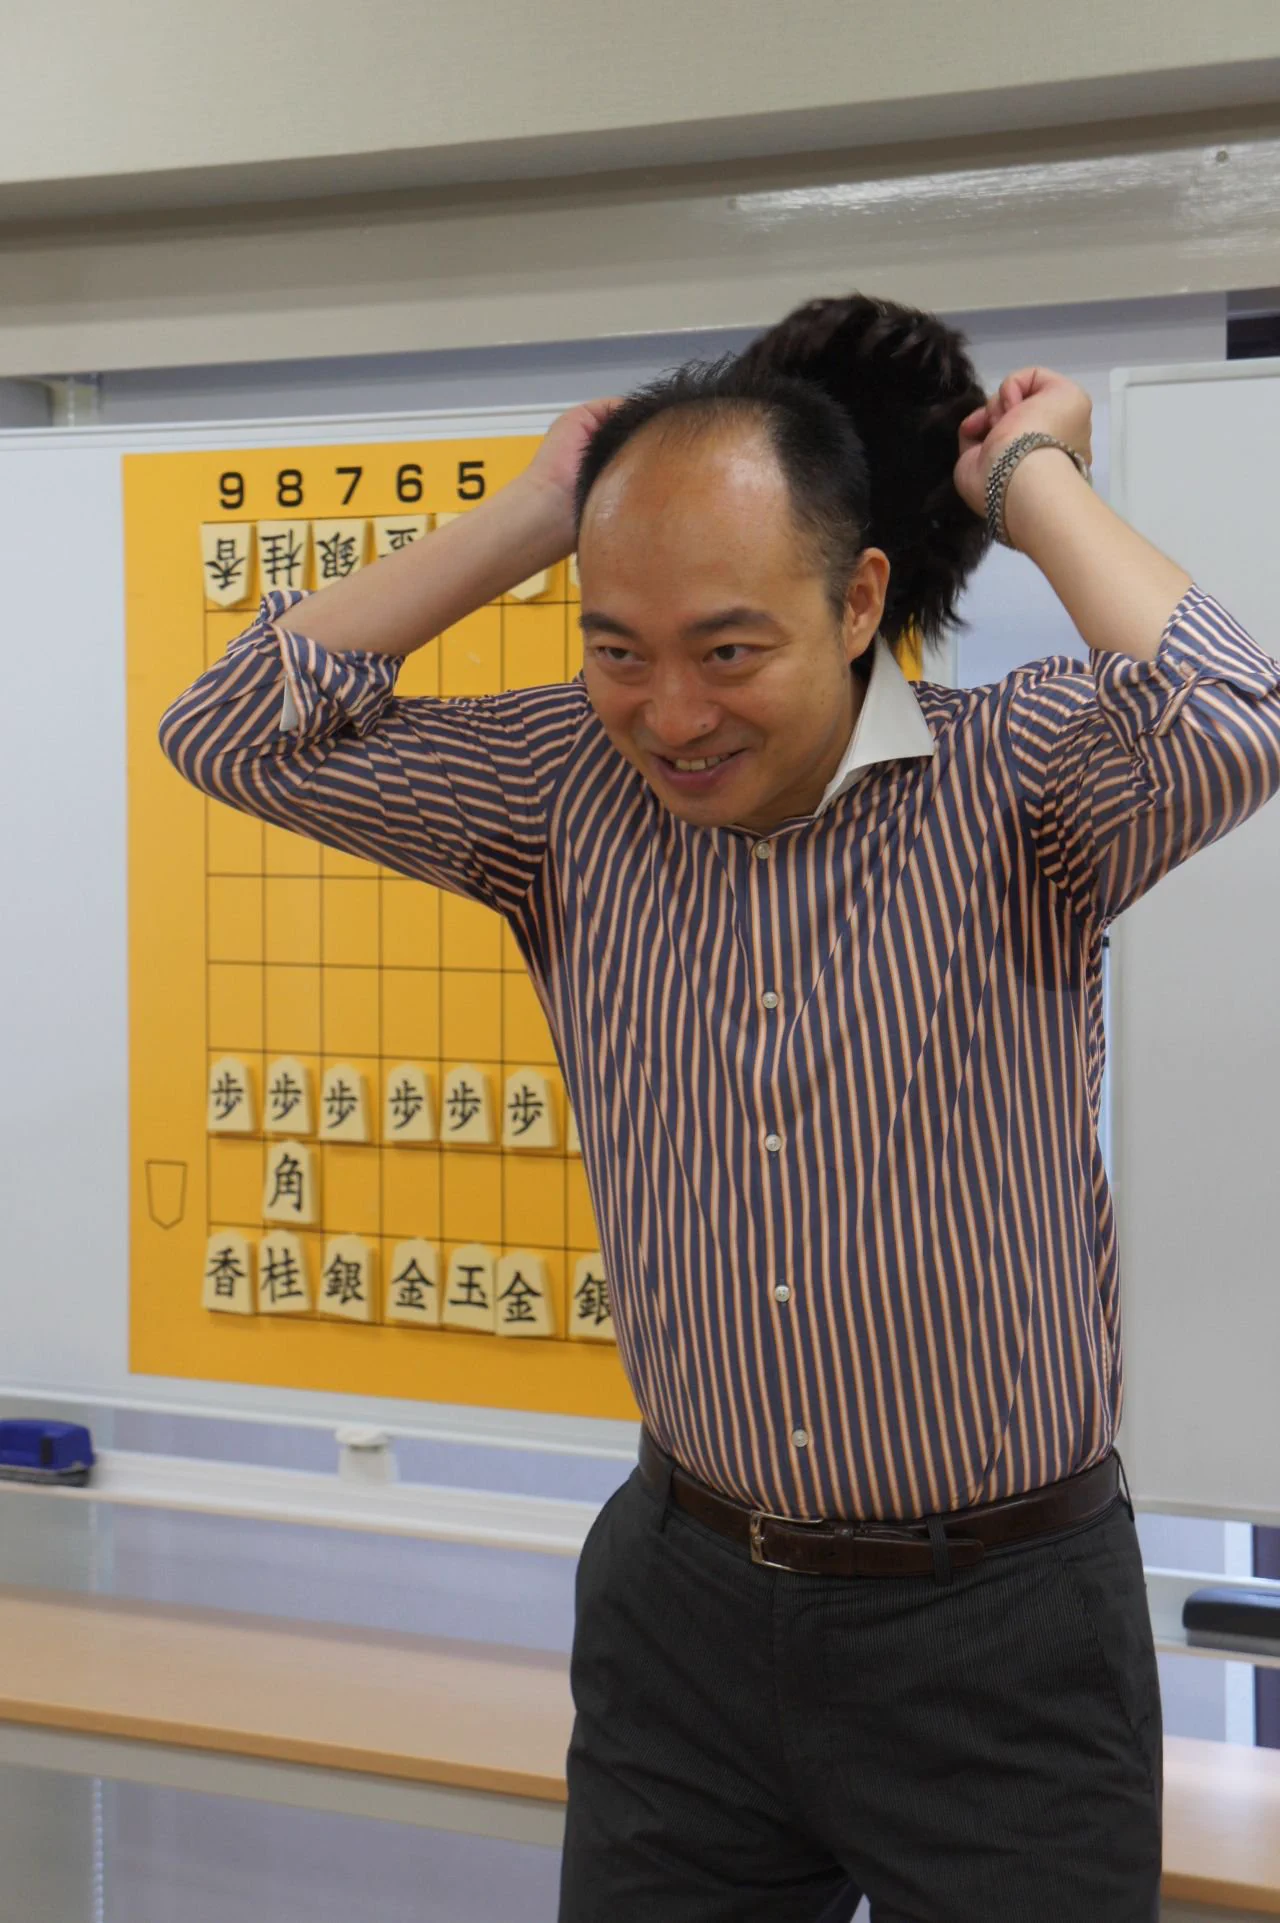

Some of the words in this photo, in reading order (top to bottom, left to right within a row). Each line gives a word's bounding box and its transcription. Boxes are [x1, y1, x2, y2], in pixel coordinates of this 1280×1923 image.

[219, 471, 245, 510] 9
[277, 469, 304, 508] 8
[335, 466, 363, 505] 7
[396, 463, 423, 504] 6
[457, 460, 485, 501] 5
[206, 539, 245, 590] 香
[261, 529, 303, 587] 桂
[211, 1072, 245, 1118] 歩
[269, 1072, 303, 1119] 歩
[325, 1080, 358, 1127] 歩
[390, 1079, 424, 1128] 歩
[446, 1080, 482, 1129] 歩
[508, 1085, 545, 1135] 歩
[268, 1153, 303, 1212] 角
[206, 1247, 246, 1297] 香
[260, 1247, 304, 1302] 桂
[323, 1255, 365, 1304] 銀
[392, 1258, 435, 1310] 金
[449, 1266, 490, 1309] 玉
[498, 1271, 542, 1323] 金
